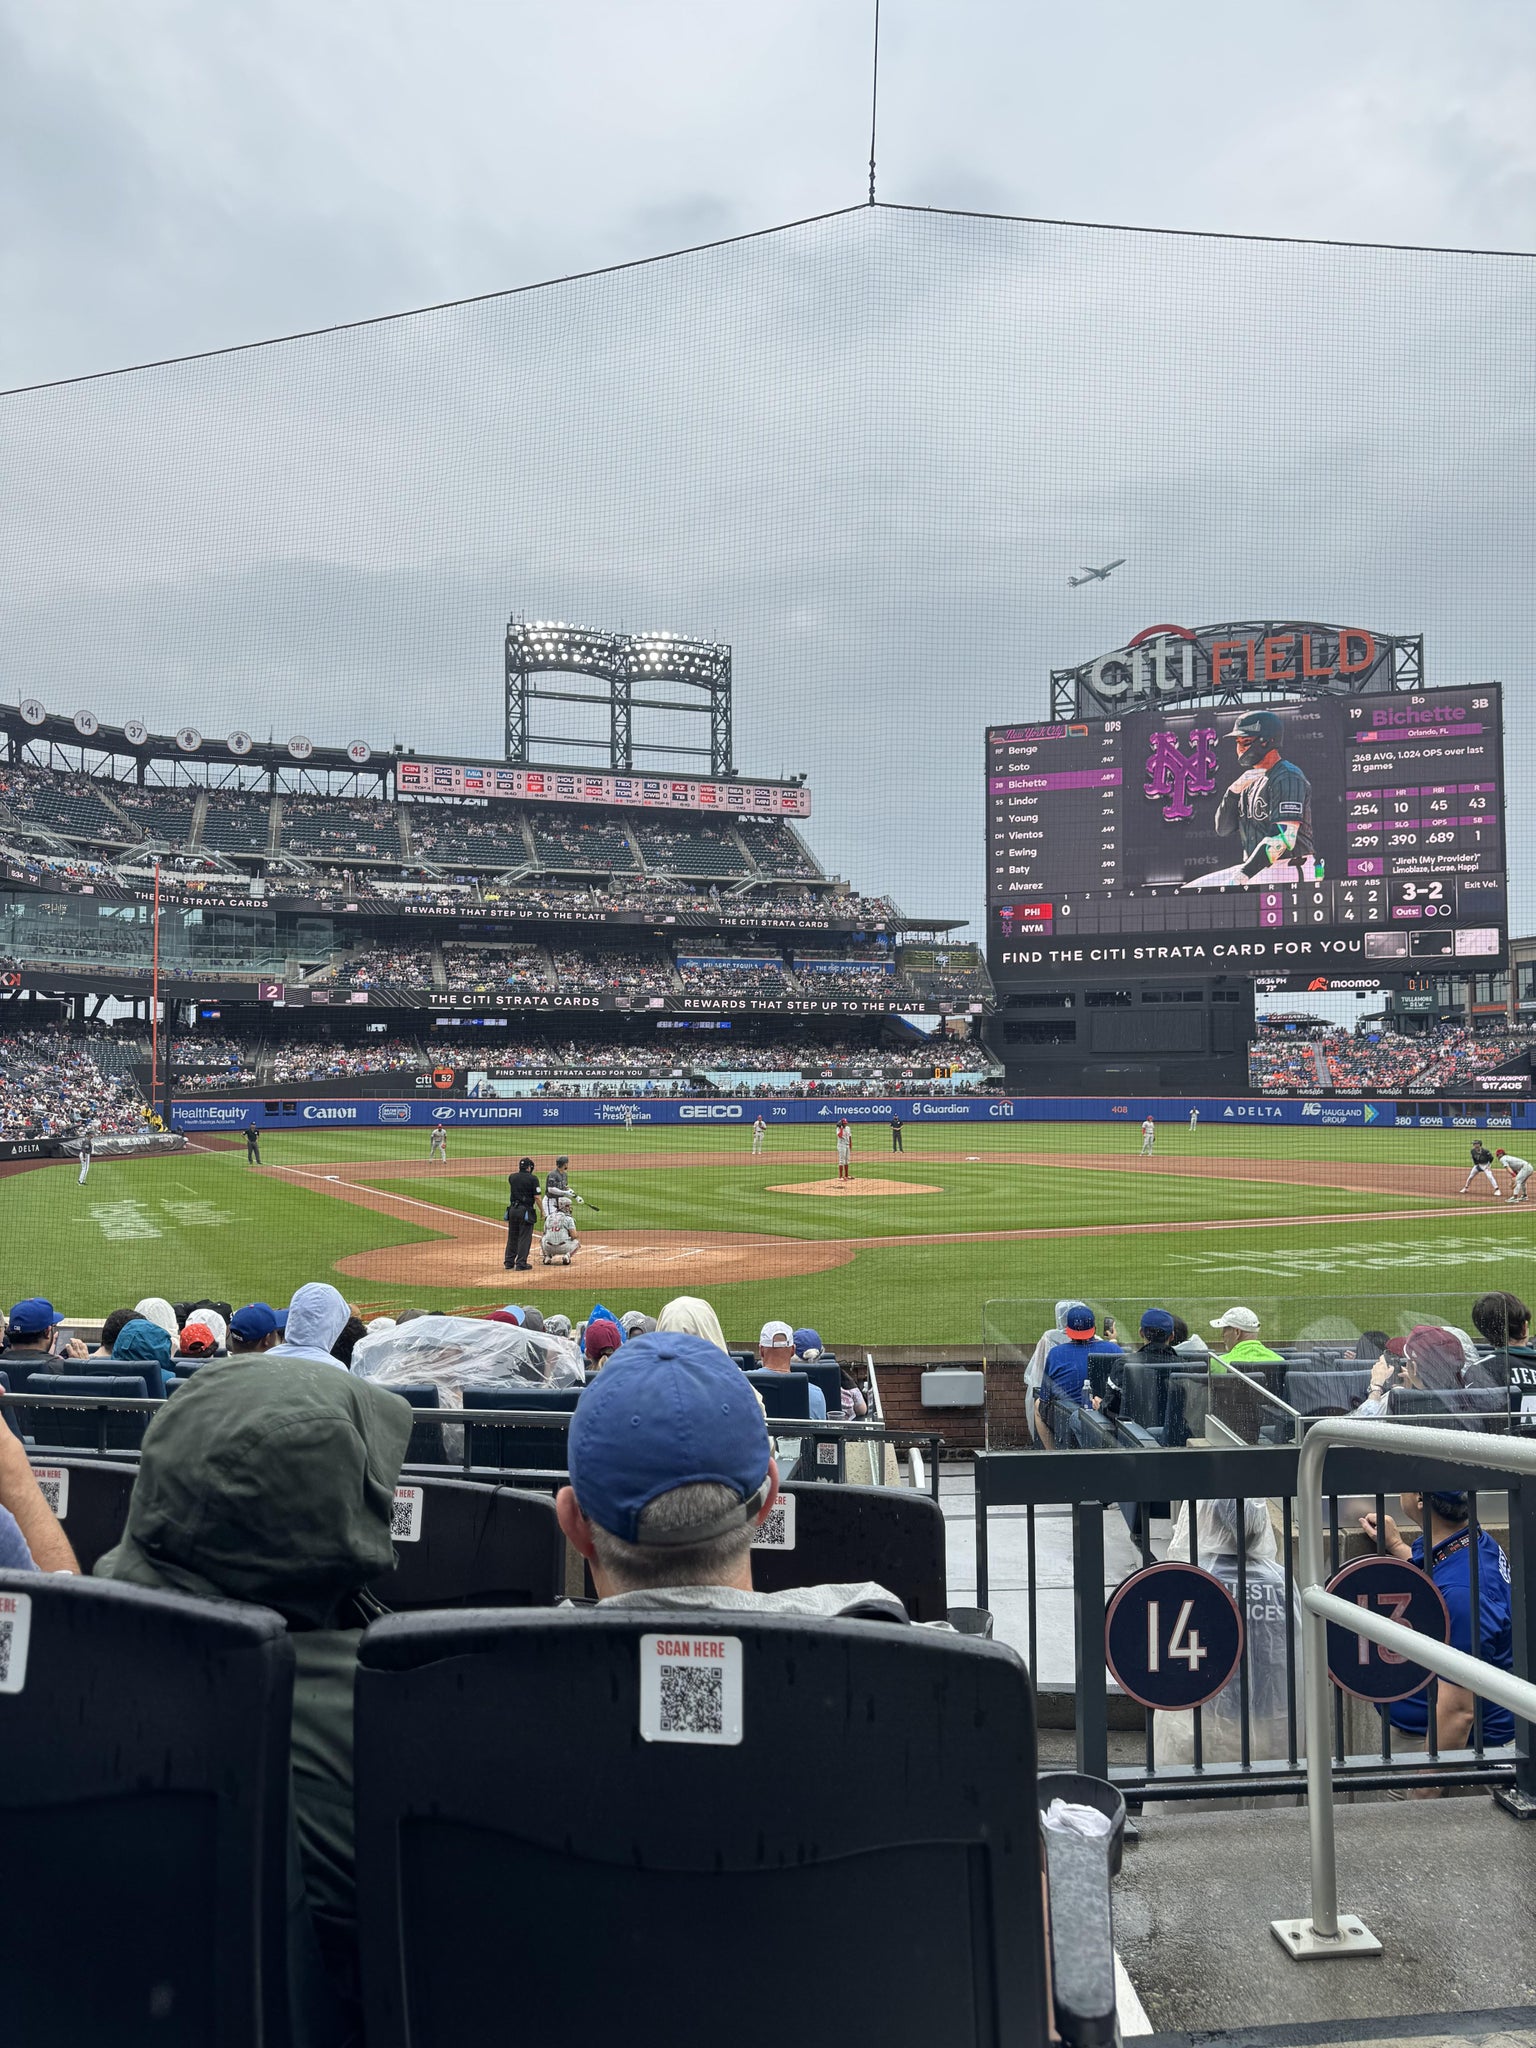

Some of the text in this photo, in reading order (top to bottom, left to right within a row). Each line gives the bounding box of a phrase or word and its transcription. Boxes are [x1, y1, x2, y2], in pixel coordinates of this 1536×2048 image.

[1091, 629, 1376, 696] citi FIELD
[1411, 696, 1425, 704] Bo
[1471, 698, 1489, 709] 3B
[26, 706, 38, 719] 41
[1349, 708, 1362, 719] 19
[1372, 705, 1467, 727] Bichette
[81, 717, 91, 729] 14
[1105, 721, 1121, 732] OPS
[129, 726, 142, 739] 37
[1407, 729, 1439, 738] Orlando,
[290, 742, 310, 752] SHEA
[351, 746, 366, 757] 42
[1008, 746, 1038, 756] Benge
[1352, 746, 1484, 762] .368 AVG, 1.024 OPS over last
[1008, 764, 1030, 772] Soto
[1352, 763, 1393, 773] 21 games
[1008, 779, 1048, 789] Bichette
[1008, 796, 1038, 806] Lindor
[1430, 800, 1448, 811] 45
[1468, 797, 1486, 809] 43
[1350, 804, 1379, 816] .254
[1394, 802, 1409, 813] 10
[1008, 814, 1039, 824] Young
[1008, 831, 1043, 840] Vientos
[1388, 834, 1417, 846] .390
[1425, 832, 1455, 844] .689
[1475, 830, 1481, 841] 1
[1351, 836, 1379, 847] .299
[1009, 848, 1038, 858] Ewing
[1419, 855, 1436, 865] (My
[1009, 866, 1030, 875] Baty
[1457, 862, 1479, 872] Happi
[1008, 882, 1044, 891] Alvarez
[1464, 880, 1498, 889] Exit Vel.
[1402, 881, 1443, 900] 3-2
[135, 891, 269, 908] THE CITI STRATA CARDS
[1024, 890, 1378, 916] PHI 0 0 1 0 4 2
[404, 906, 456, 915] REWARDS
[460, 908, 487, 916] THAT
[490, 909, 516, 917] STEP
[519, 910, 533, 918] UP
[536, 911, 550, 919] TO
[575, 912, 607, 921] PLATE
[1396, 907, 1420, 916] Outs:
[719, 917, 829, 929] THE CITI STRATA CARDS
[1021, 908, 1378, 933] NYM 0 1 0 4 2
[1002, 940, 1361, 964] FIND THE CITI STRATA CARD FOR YOU
[1331, 979, 1380, 988] moomoo
[266, 986, 278, 998] 2
[429, 994, 600, 1006] THE CITI STRATA CARDS
[684, 999, 925, 1012] REWARDS THAT STEP UP TO THE PLATE
[441, 1074, 452, 1082] 52
[1482, 1082, 1522, 1091] $17,405
[303, 1106, 357, 1119] Canon
[459, 1107, 522, 1118] HYUNDAI
[542, 1108, 559, 1117] 358
[679, 1105, 742, 1118] GEICO
[772, 1107, 787, 1115] 370
[834, 1105, 892, 1115] Invesco QQQ
[923, 1104, 970, 1114] Guardian
[989, 1102, 1014, 1116] citi
[1111, 1105, 1128, 1114] 408
[1237, 1106, 1282, 1117] DELTA
[1321, 1109, 1362, 1117] HAUGLAND
[1321, 1116, 1347, 1124] GROUP
[1394, 1117, 1411, 1126] 380
[1420, 1117, 1443, 1125] GOYA
[1452, 1117, 1477, 1125] GOYA
[1487, 1118, 1512, 1126] GOYA
[18, 1144, 40, 1154] DELTA
[1357, 1593, 1414, 1665] 13
[1147, 1600, 1208, 1673] 14
[656, 1639, 725, 1658] SCAN HERE
